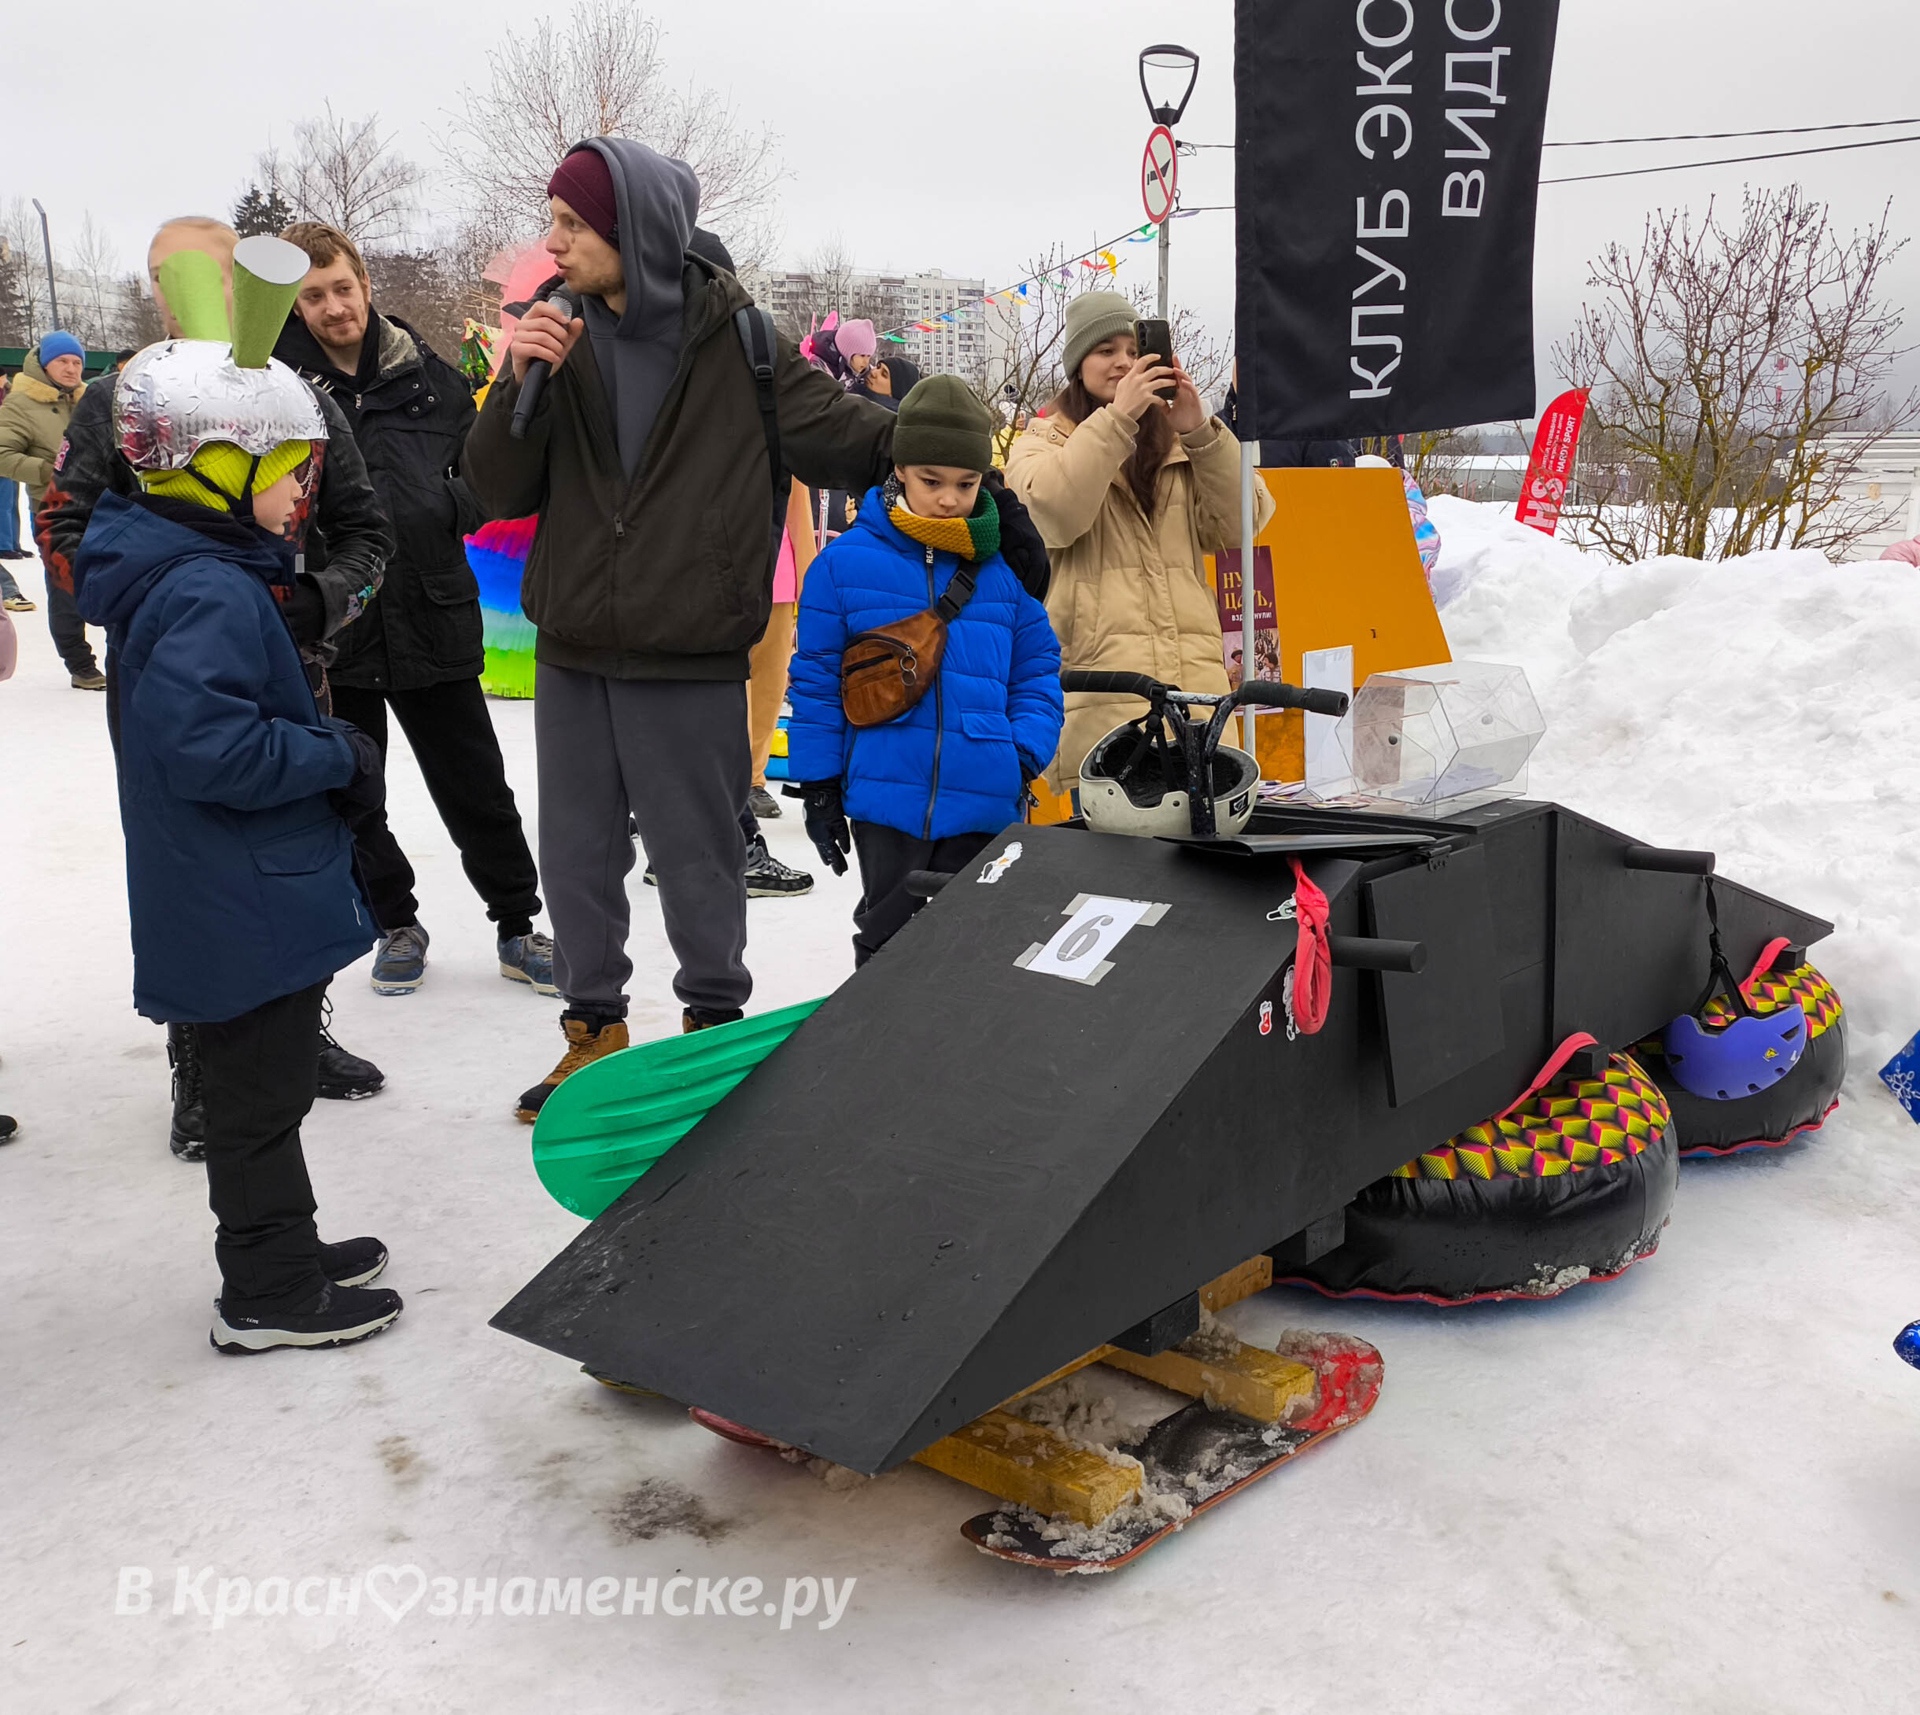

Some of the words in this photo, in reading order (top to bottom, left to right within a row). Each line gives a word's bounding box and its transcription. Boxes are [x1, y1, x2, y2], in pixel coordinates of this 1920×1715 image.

[1349, 189, 1410, 399] КЛУБ
[1556, 442, 1569, 473] HARDY
[1563, 415, 1576, 443] SPORT
[1523, 477, 1564, 528] HS
[1057, 914, 1113, 961] 6
